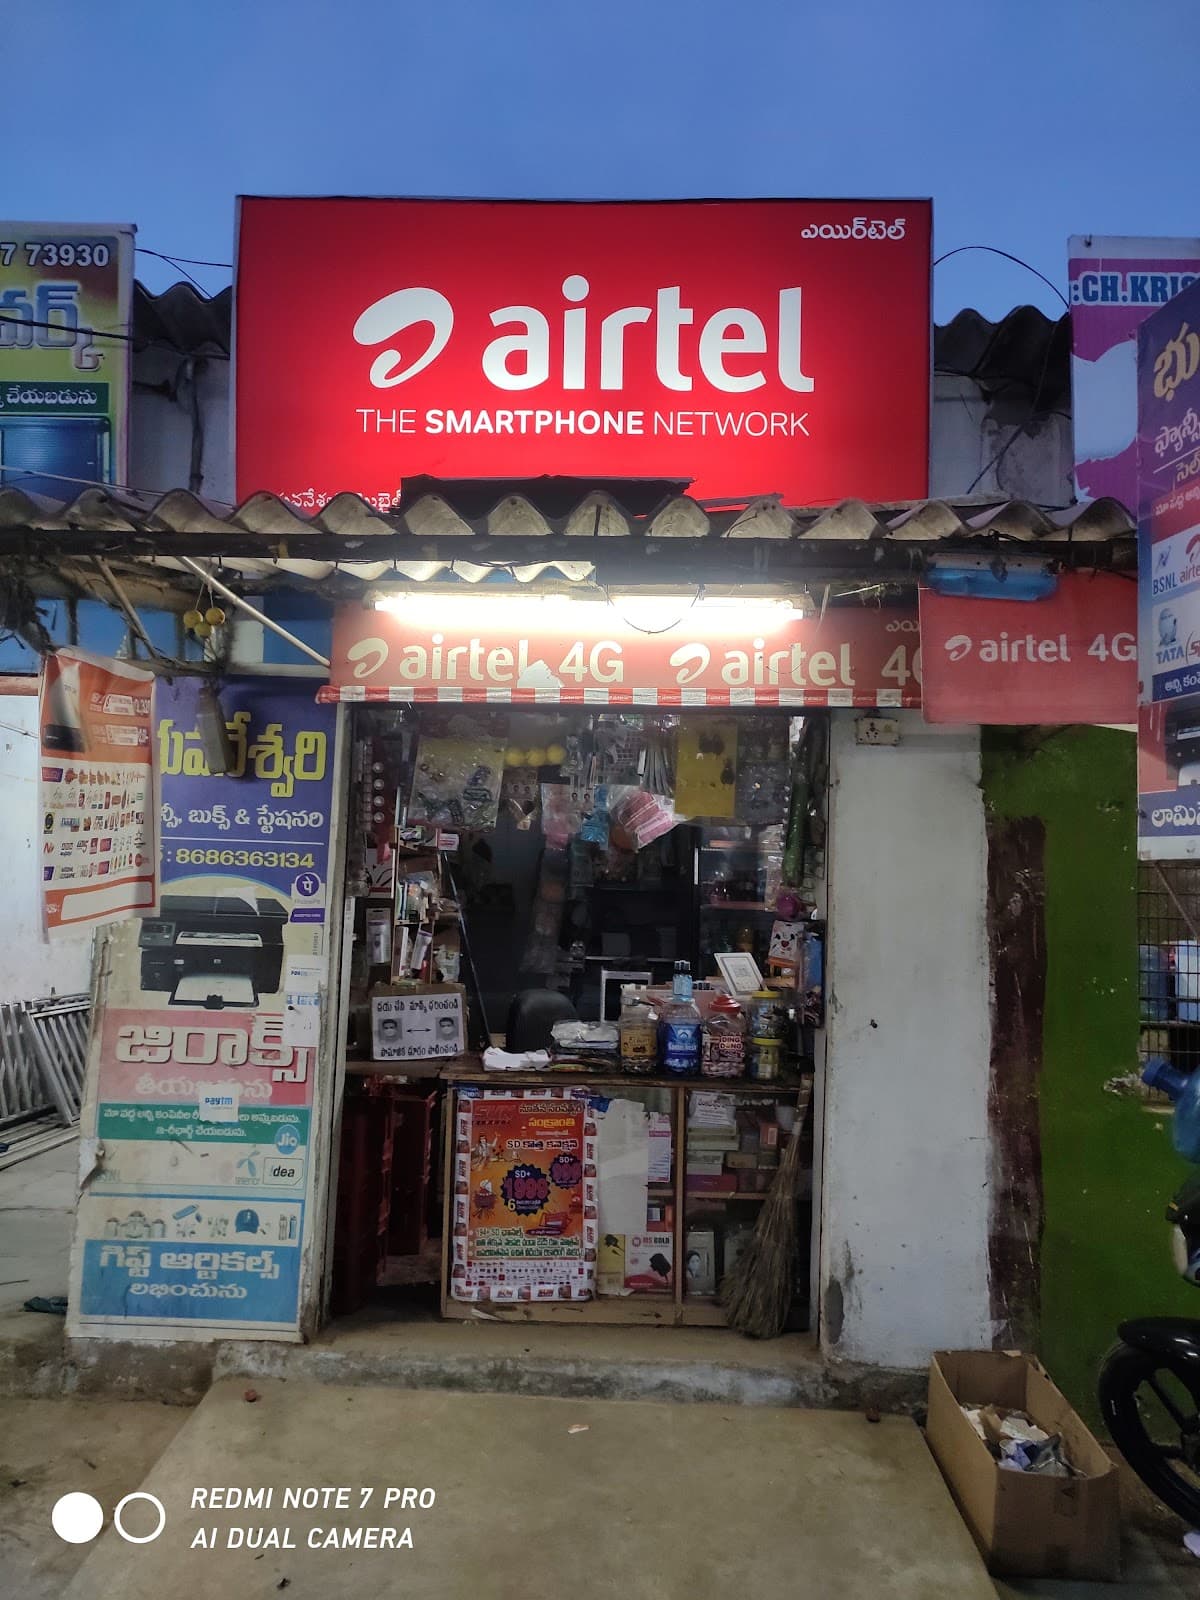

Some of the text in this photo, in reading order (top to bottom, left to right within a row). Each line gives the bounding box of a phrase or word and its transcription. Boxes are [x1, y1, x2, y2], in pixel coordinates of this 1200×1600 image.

[25, 243, 110, 267] 73930
[481, 274, 815, 393] airtel
[356, 408, 810, 437] THE SMARTPHONE NETWORK
[1152, 571, 1177, 595] BSNL
[400, 632, 625, 683] airtel 4G
[978, 631, 1137, 663] airtel 4G
[1156, 645, 1184, 665] TATA
[721, 636, 922, 687] airtel 4
[234, 808, 250, 825] &
[175, 848, 315, 868] 8686363134
[278, 1132, 298, 1147] Jio
